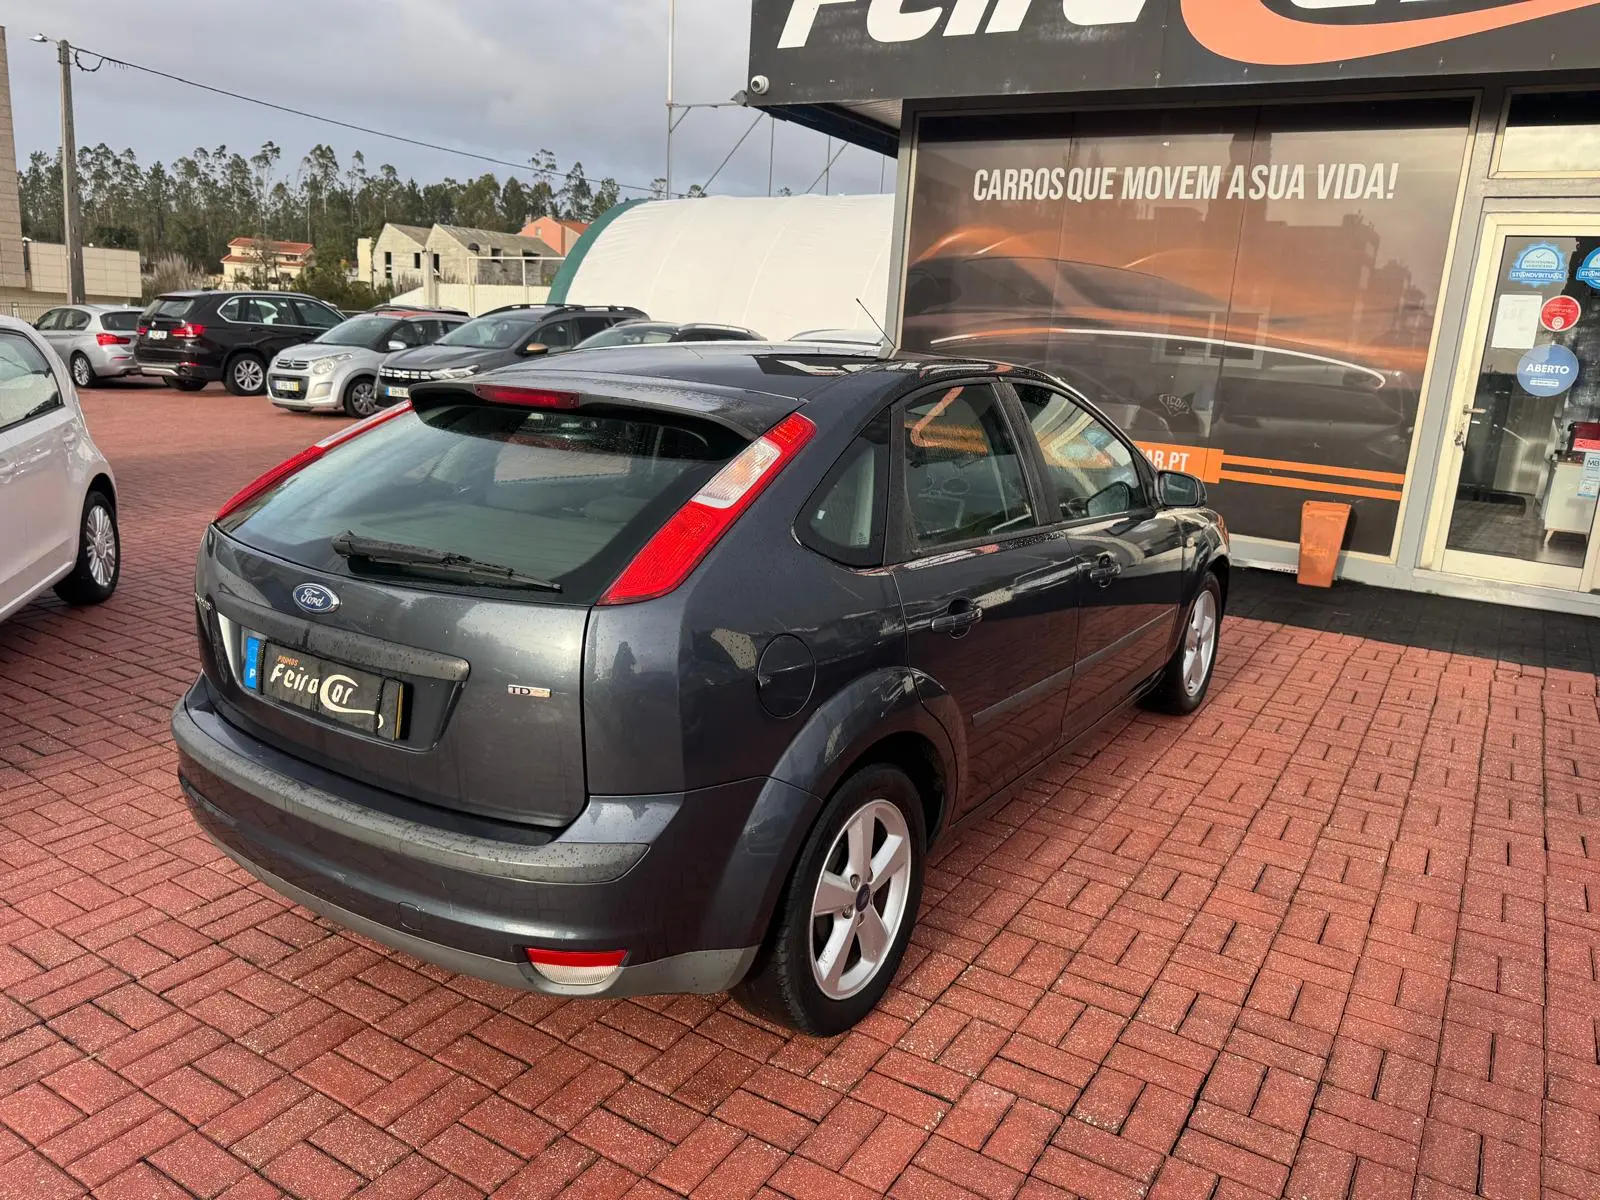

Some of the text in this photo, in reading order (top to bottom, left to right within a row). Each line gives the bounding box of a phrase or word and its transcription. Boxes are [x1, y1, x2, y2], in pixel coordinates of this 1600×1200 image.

[973, 162, 1400, 203] CARROS QUE MOVEM A SUA VIDA!
[1525, 363, 1570, 375] ABERTO
[300, 587, 325, 607] Ford
[249, 668, 257, 679] P
